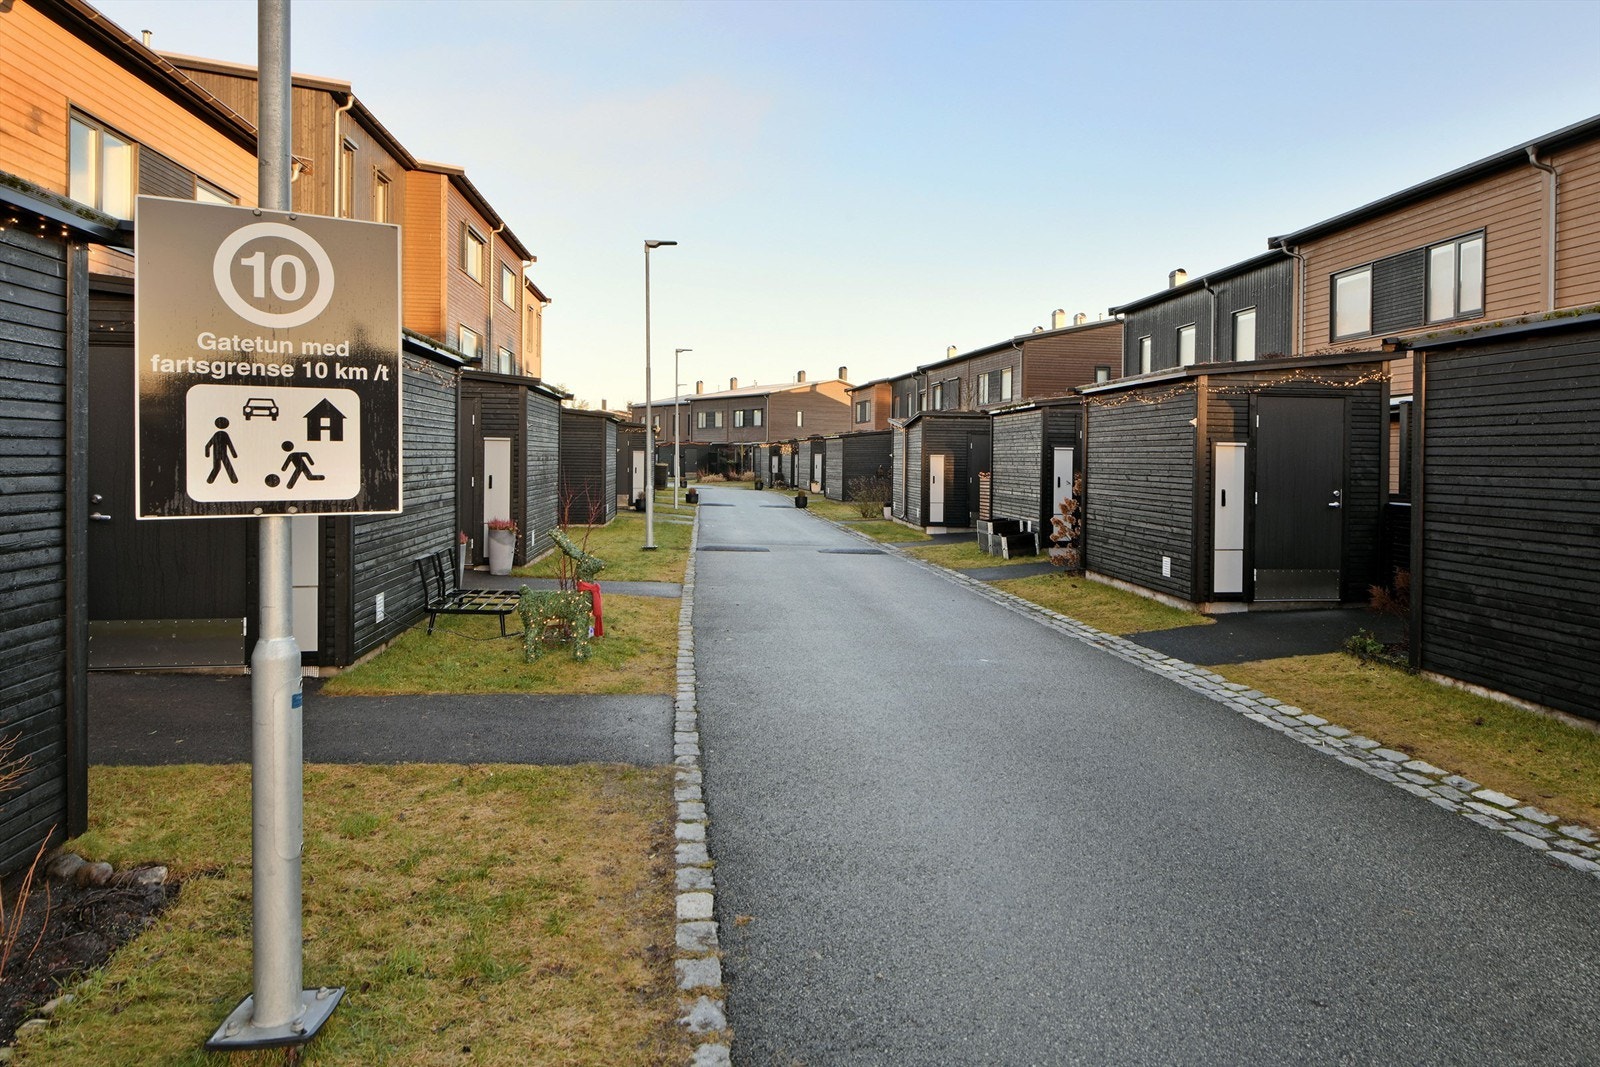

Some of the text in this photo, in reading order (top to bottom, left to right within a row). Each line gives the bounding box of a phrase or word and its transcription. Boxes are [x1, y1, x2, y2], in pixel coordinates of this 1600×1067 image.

[241, 251, 306, 301] 10
[197, 332, 350, 357] Gatetun med
[150, 354, 389, 381] fartsgrense 10 km /t
